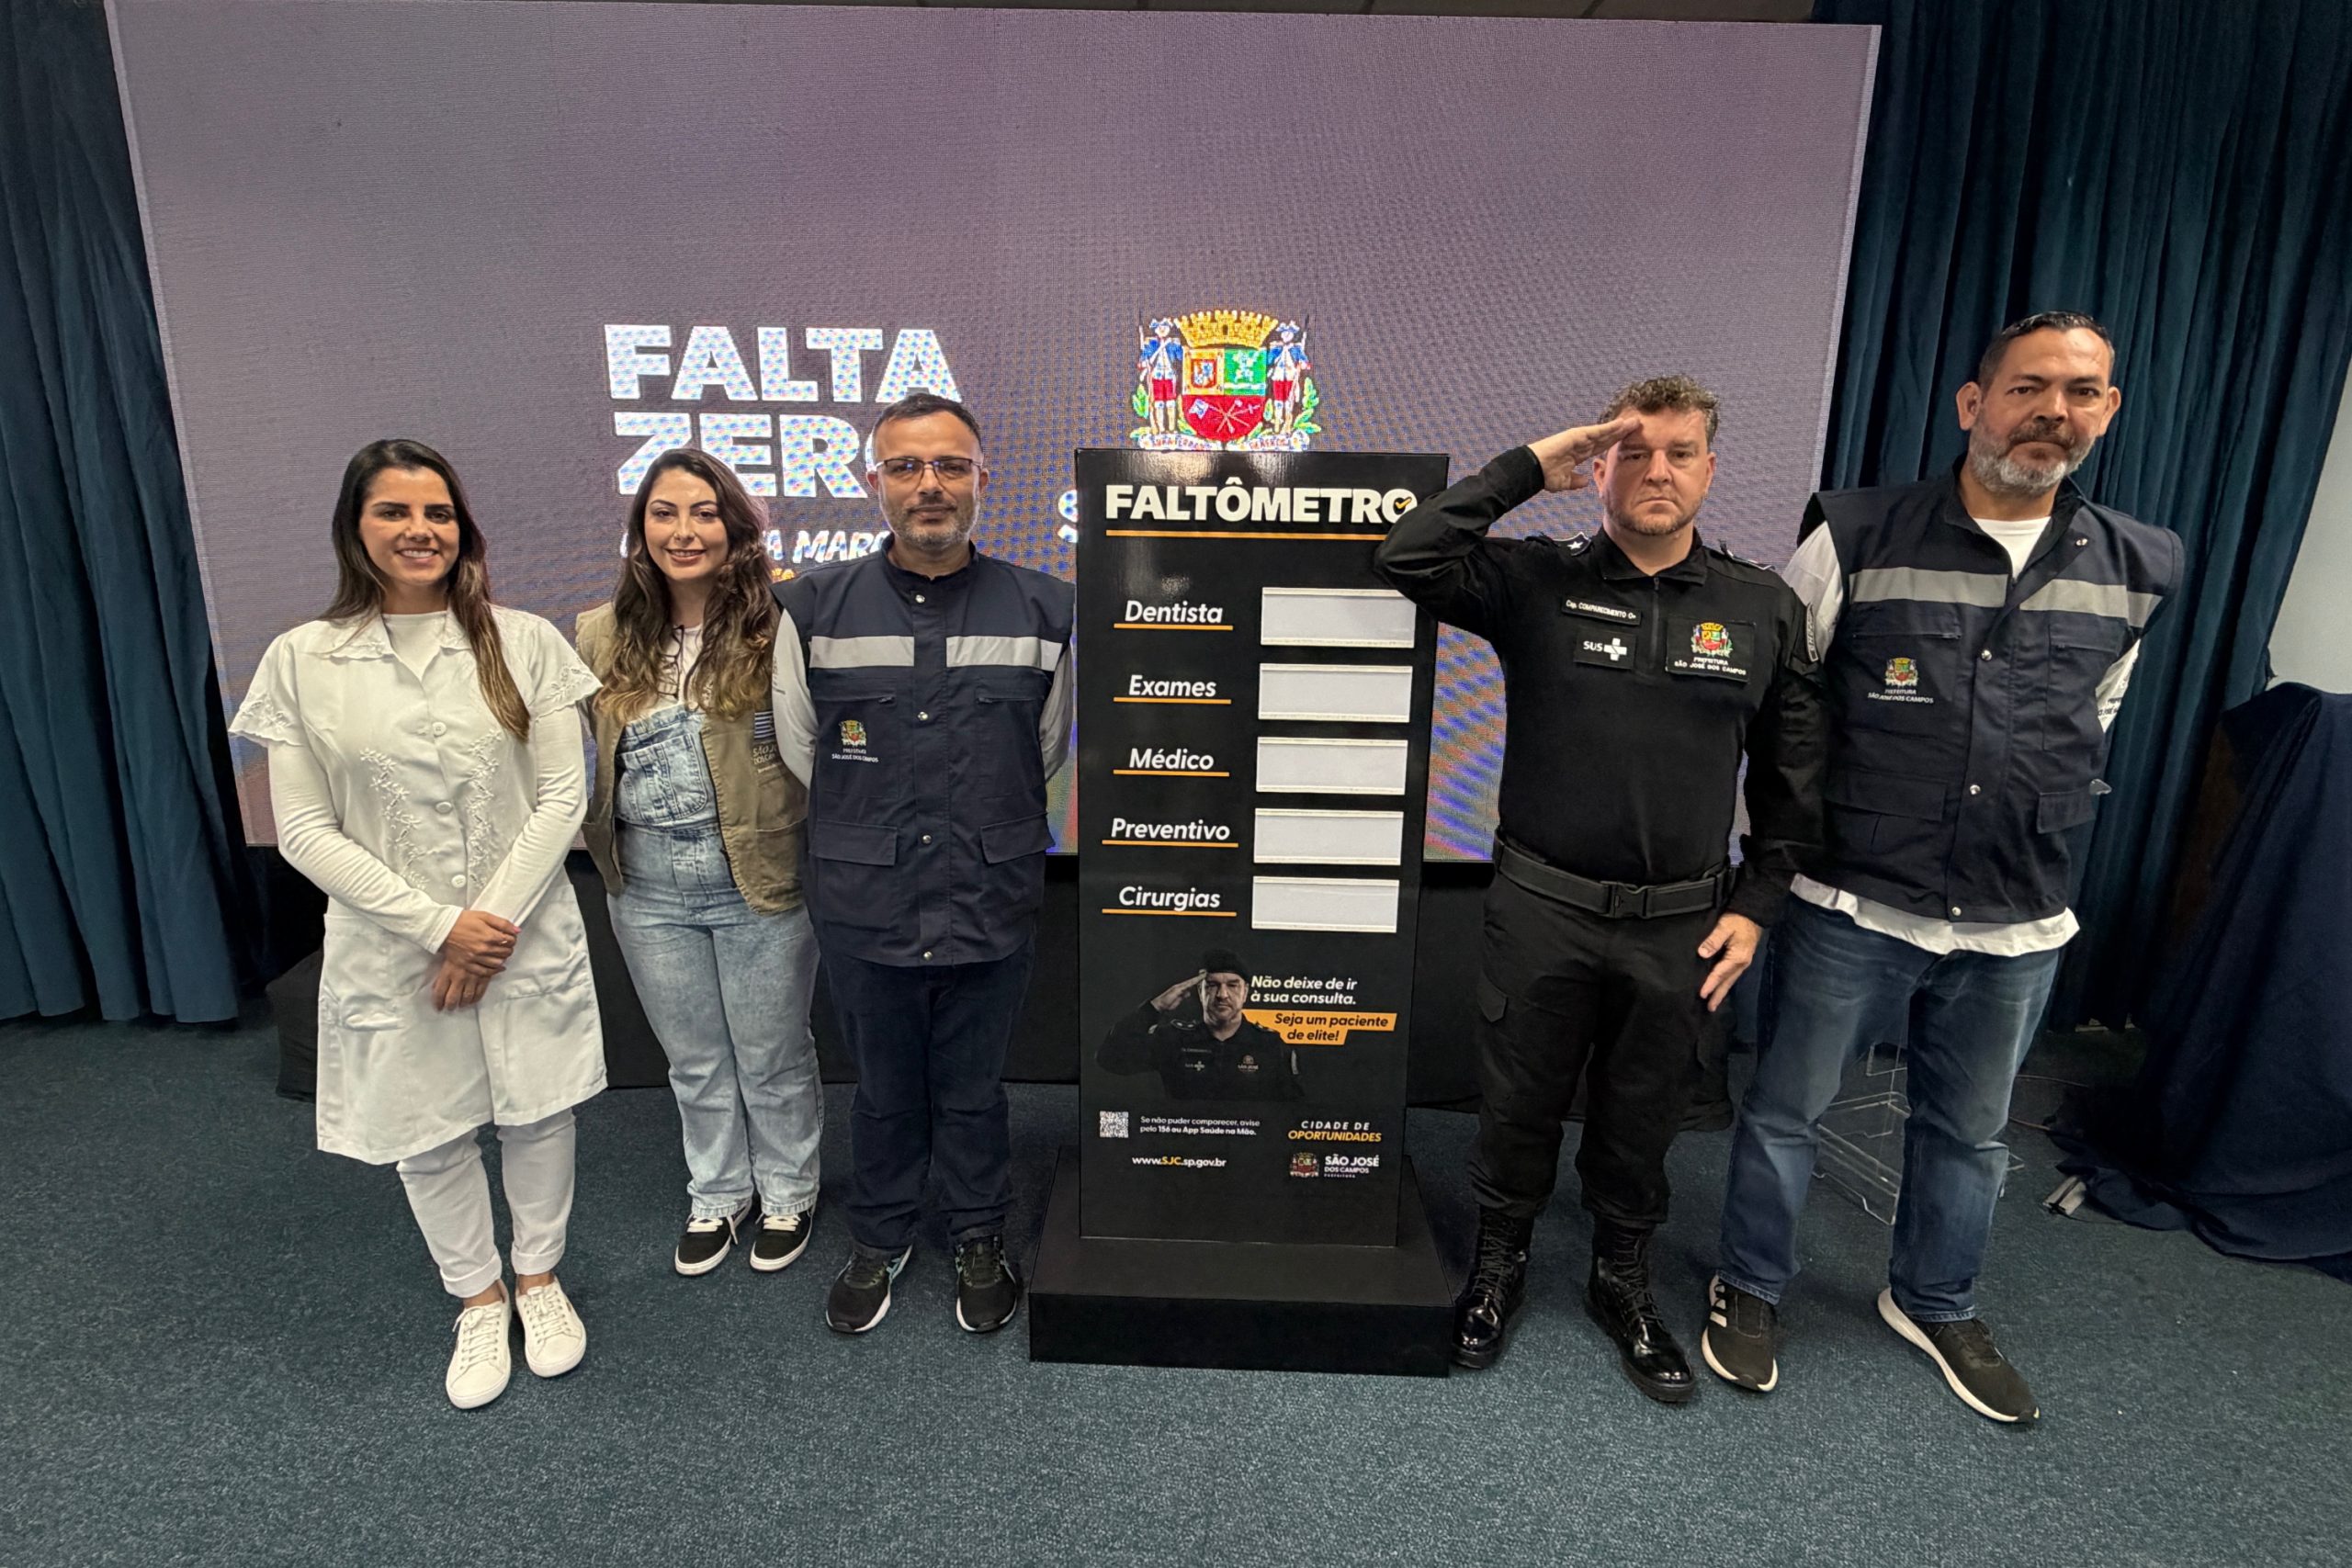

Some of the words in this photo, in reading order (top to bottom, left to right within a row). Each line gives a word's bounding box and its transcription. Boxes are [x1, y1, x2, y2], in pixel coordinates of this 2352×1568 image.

[604, 324, 963, 403] FALTA
[614, 412, 875, 499] ZER
[1105, 476, 1418, 525] FALTÔMETRO
[1125, 600, 1223, 624] Dentista
[1583, 640, 1603, 652] SUS
[1722, 666, 1747, 676] CAMPOS
[1128, 674, 1216, 698] Exames
[1128, 747, 1215, 771] Médico
[1111, 818, 1230, 840] Preventivo
[1119, 886, 1221, 912] Cirurgias
[1250, 976, 1282, 988] Não
[1283, 976, 1323, 990] deixe
[1325, 977, 1344, 990] de
[1346, 977, 1358, 991] ir
[1250, 990, 1261, 1003] à
[1263, 993, 1289, 1003] sua
[1292, 992, 1357, 1005] consulta.
[1274, 1013, 1304, 1027] Seja
[1306, 1016, 1327, 1025] um
[1329, 1015, 1388, 1028] paciente
[1287, 1030, 1304, 1040] de
[1306, 1030, 1340, 1041] elite!
[1151, 1116, 1167, 1124] não
[1167, 1117, 1191, 1127] puder
[1239, 1119, 1261, 1127] avise
[1301, 1121, 1349, 1131] CIDADE
[1354, 1122, 1370, 1131] DE
[1139, 1125, 1158, 1134] pelo
[1182, 1126, 1199, 1134] App
[1200, 1126, 1225, 1134] Saúde
[1237, 1127, 1257, 1135] Mão.
[1287, 1130, 1382, 1142] OPORTUNIDADES
[1132, 1156, 1227, 1168] www.SJC.sp.gov.br
[1325, 1154, 1350, 1166] SÃO
[1351, 1154, 1380, 1167] JOSÉ
